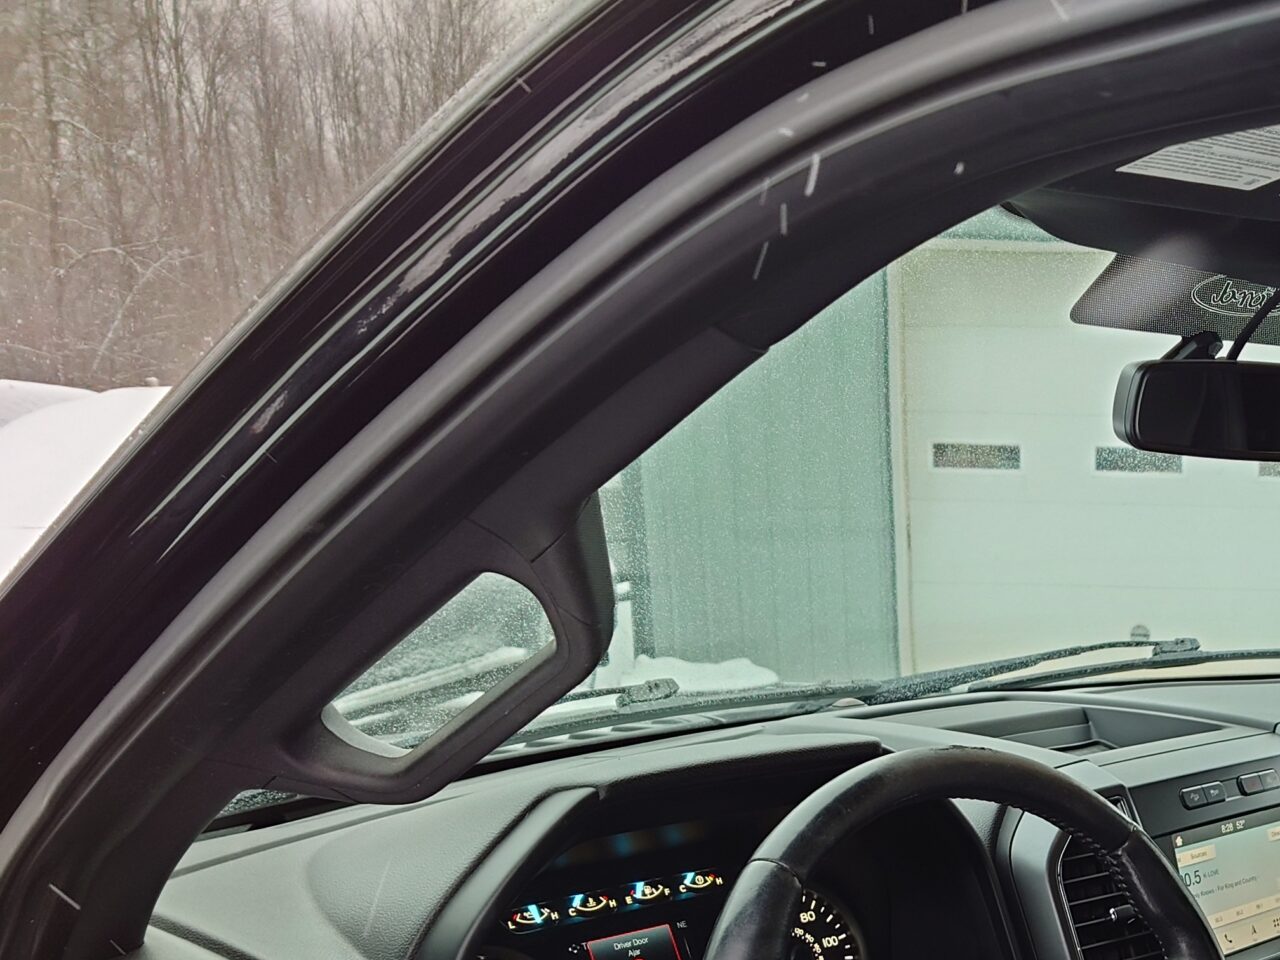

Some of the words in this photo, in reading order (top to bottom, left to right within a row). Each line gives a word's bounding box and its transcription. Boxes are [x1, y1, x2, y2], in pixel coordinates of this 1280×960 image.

[679, 884, 687, 893] C
[715, 877, 723, 885] H
[1180, 870, 1201, 887] 0.5
[625, 896, 633, 904] E
[663, 888, 671, 896] F
[568, 908, 576, 916] C
[609, 899, 617, 908] H
[550, 911, 559, 920] H
[800, 911, 816, 923] 80
[613, 941, 632, 951] Driver
[633, 937, 649, 946] Door
[822, 935, 838, 948] 100
[628, 949, 641, 957] Ajar
